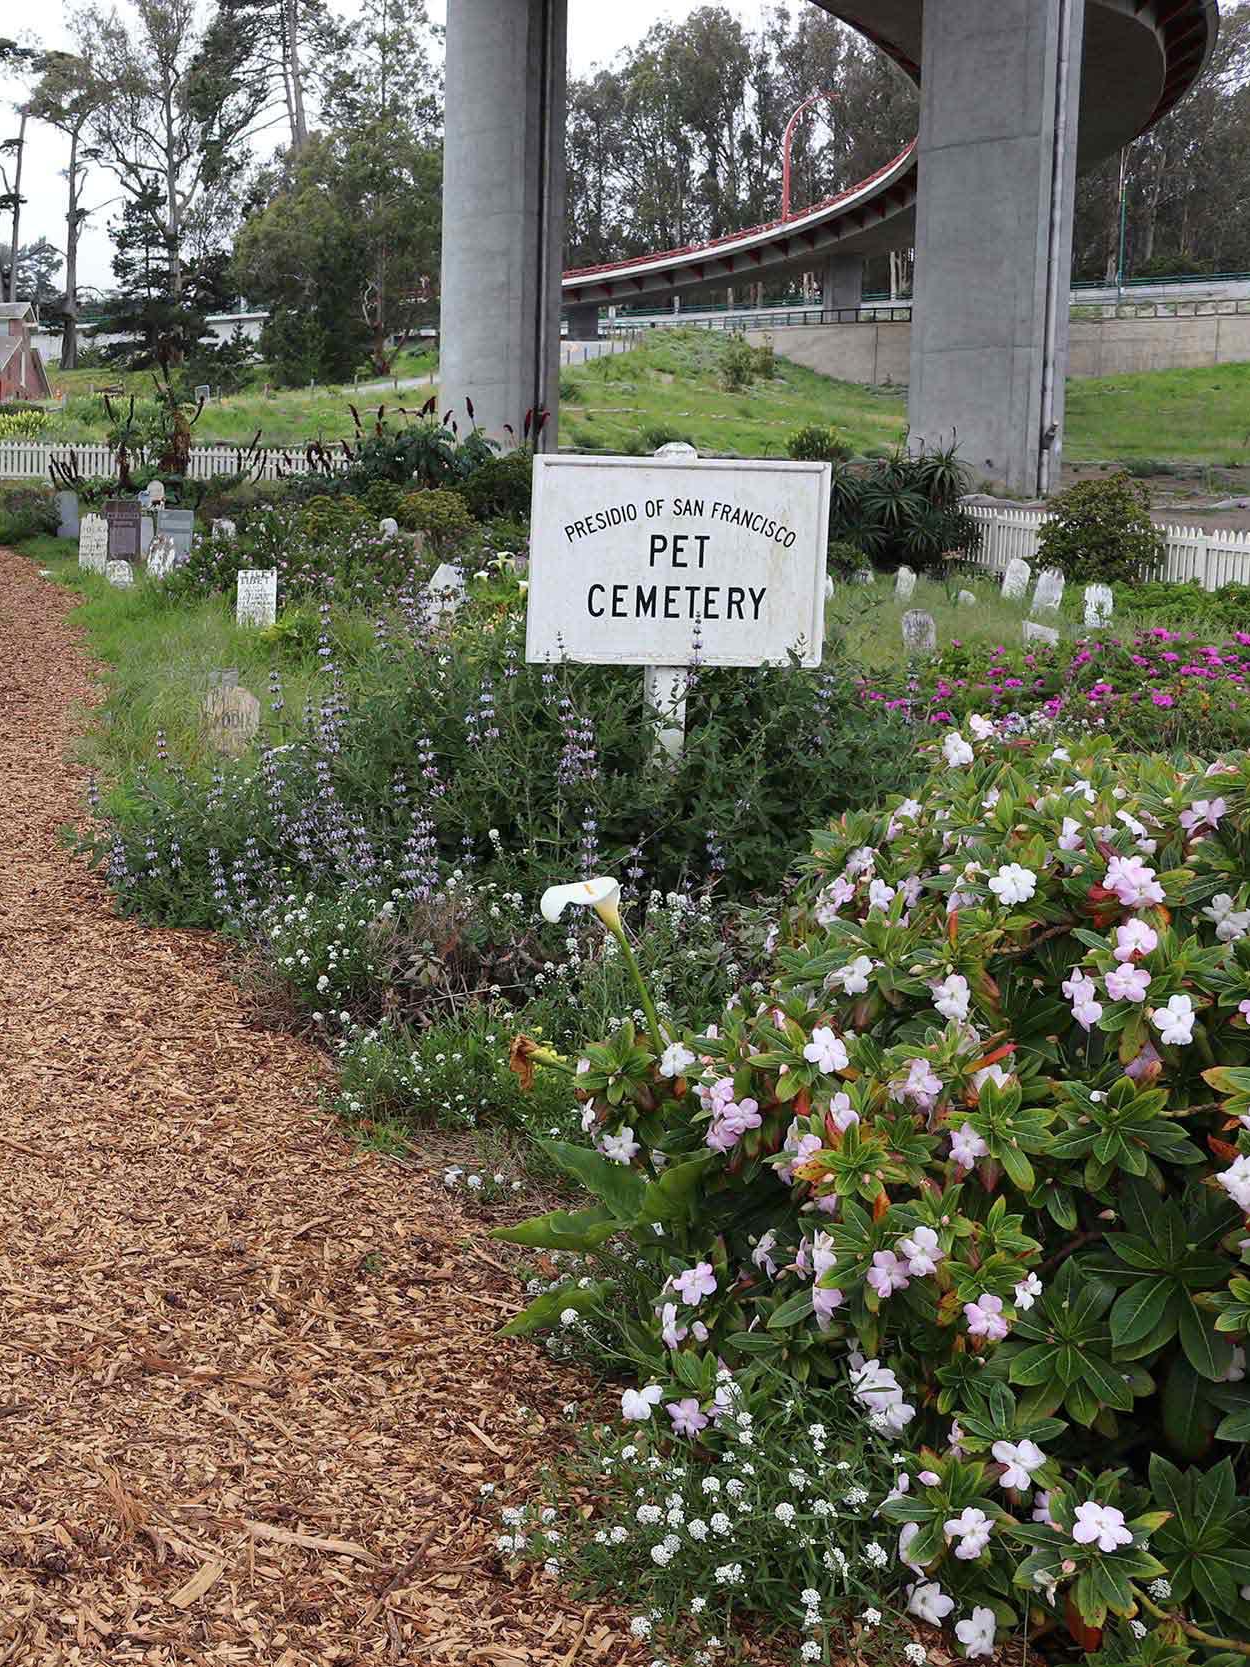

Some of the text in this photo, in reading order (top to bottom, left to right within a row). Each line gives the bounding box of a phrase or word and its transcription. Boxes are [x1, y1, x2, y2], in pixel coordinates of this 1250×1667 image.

[564, 498, 797, 549] PRESIDIO OF SAN FRANCISCO
[649, 534, 710, 568] PET
[587, 584, 767, 620] CEMETERY
